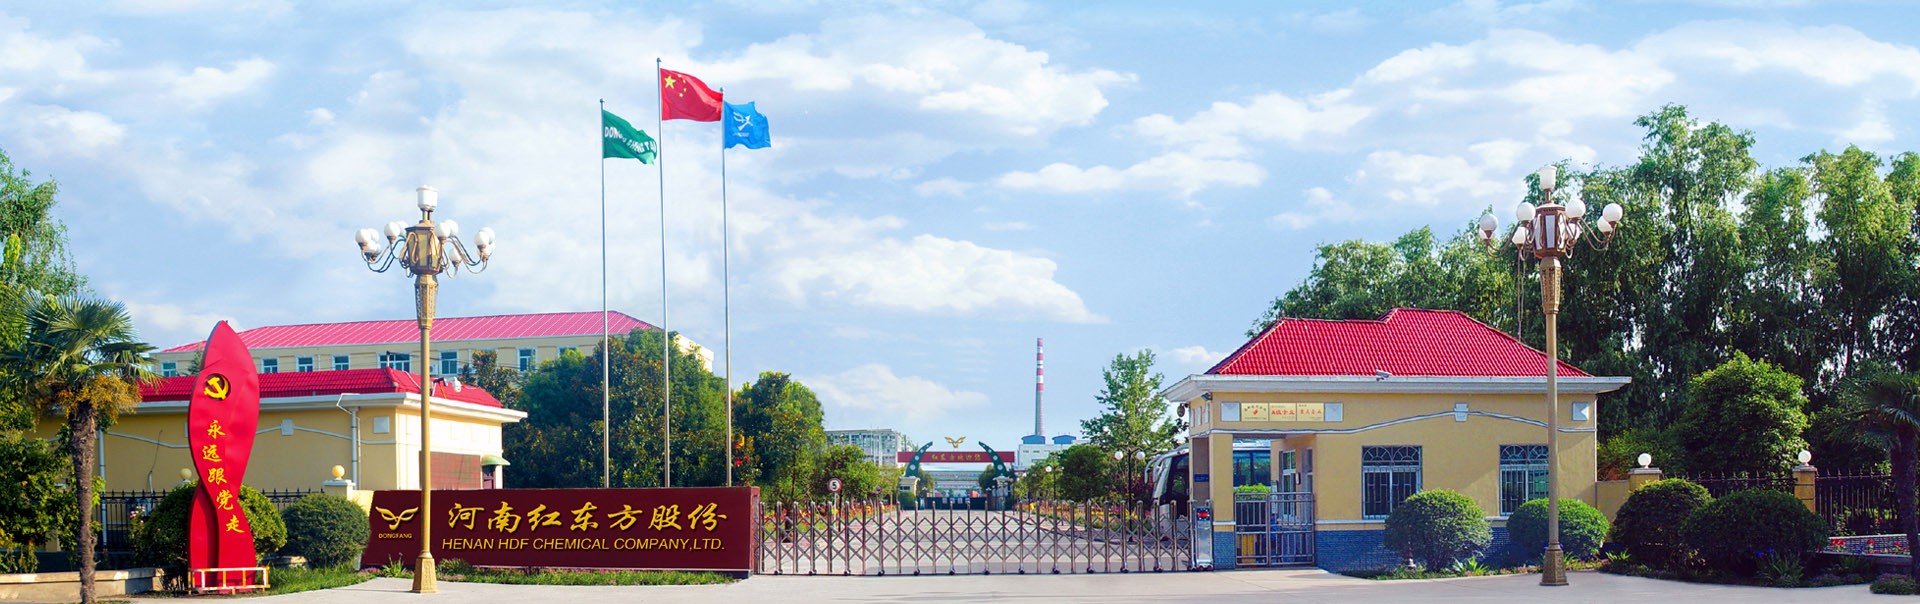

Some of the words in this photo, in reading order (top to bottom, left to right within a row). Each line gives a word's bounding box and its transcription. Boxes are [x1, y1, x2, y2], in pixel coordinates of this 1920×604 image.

[202, 420, 245, 533] 永远跟党走
[831, 481, 837, 490] 5
[448, 501, 728, 534] 河南红东方股份
[442, 538, 494, 550] HENAN
[498, 538, 529, 550] HDF
[532, 538, 610, 550] CHEMICAL
[614, 537, 725, 551] COMPANY,LTD.
